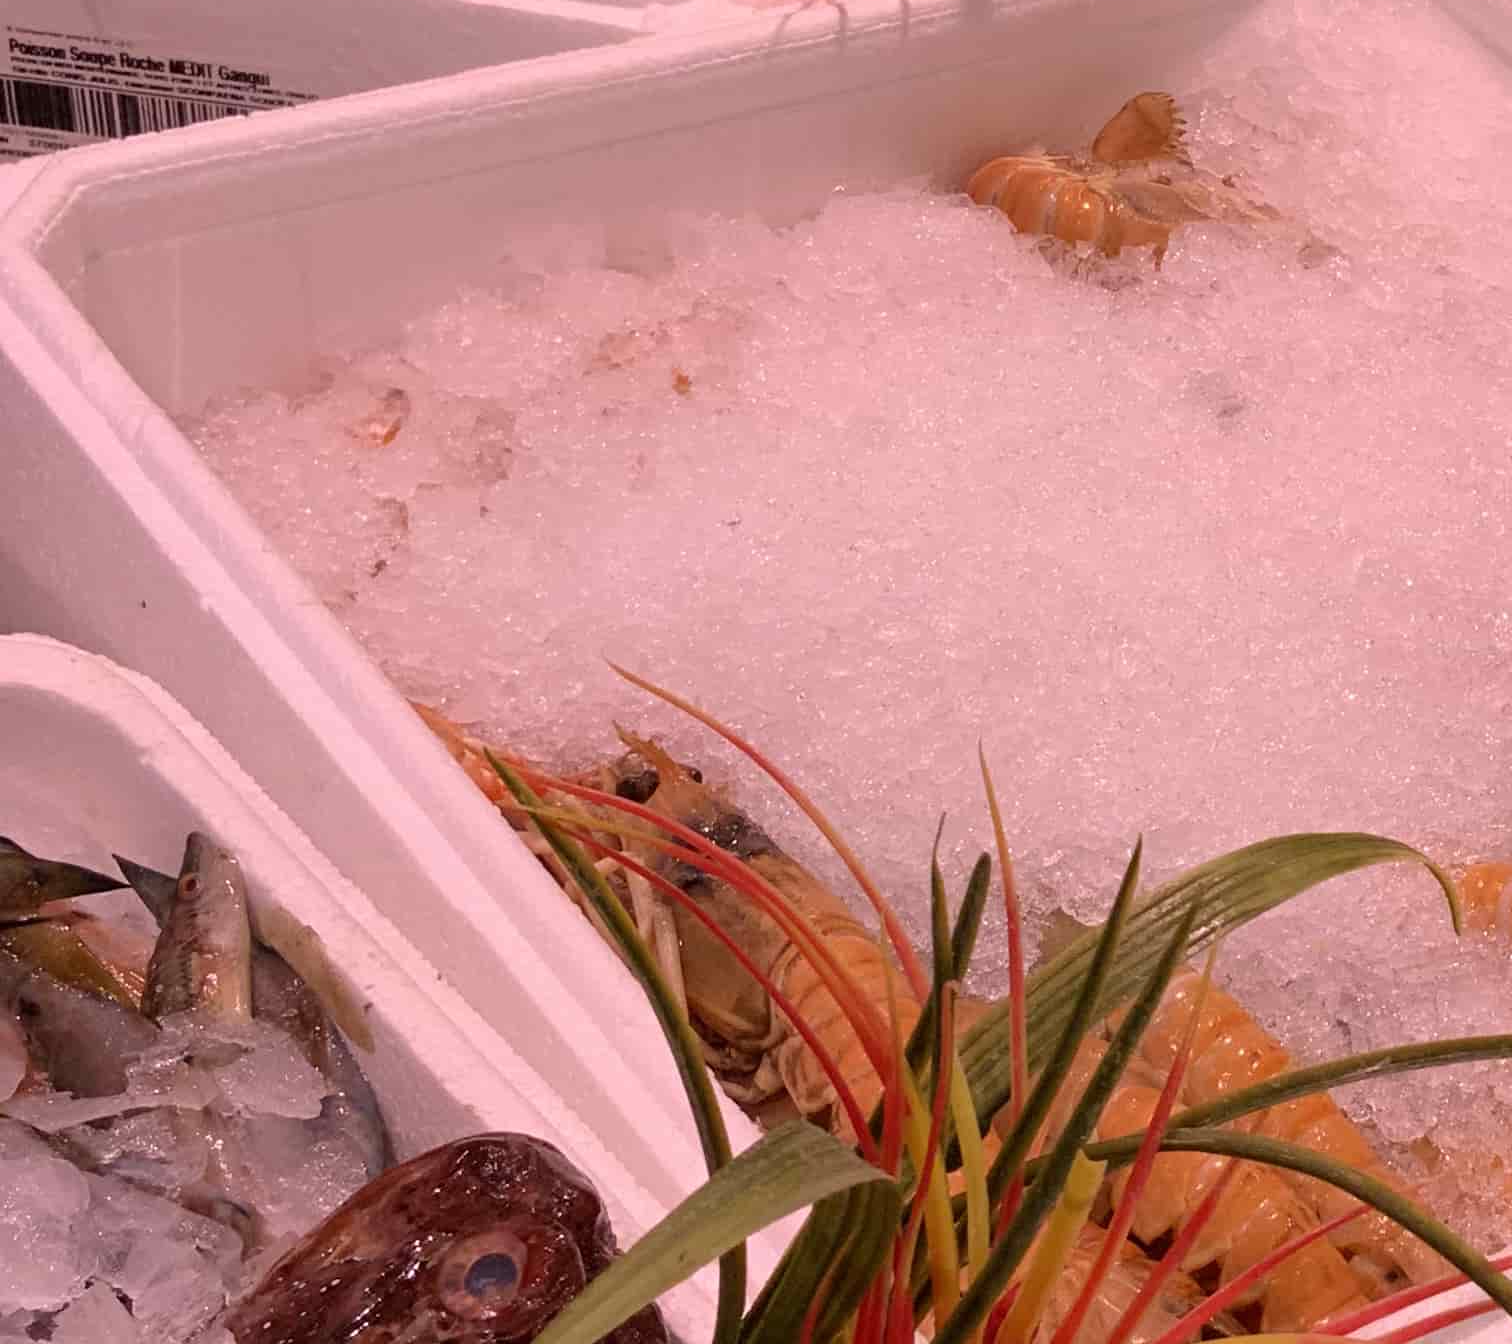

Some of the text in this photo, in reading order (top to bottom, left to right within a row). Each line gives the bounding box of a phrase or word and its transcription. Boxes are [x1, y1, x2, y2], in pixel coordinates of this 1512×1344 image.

[8, 38, 67, 60] Poisson
[70, 46, 116, 67] Soupe
[119, 53, 166, 72] Roche
[169, 58, 213, 79] MEDIT
